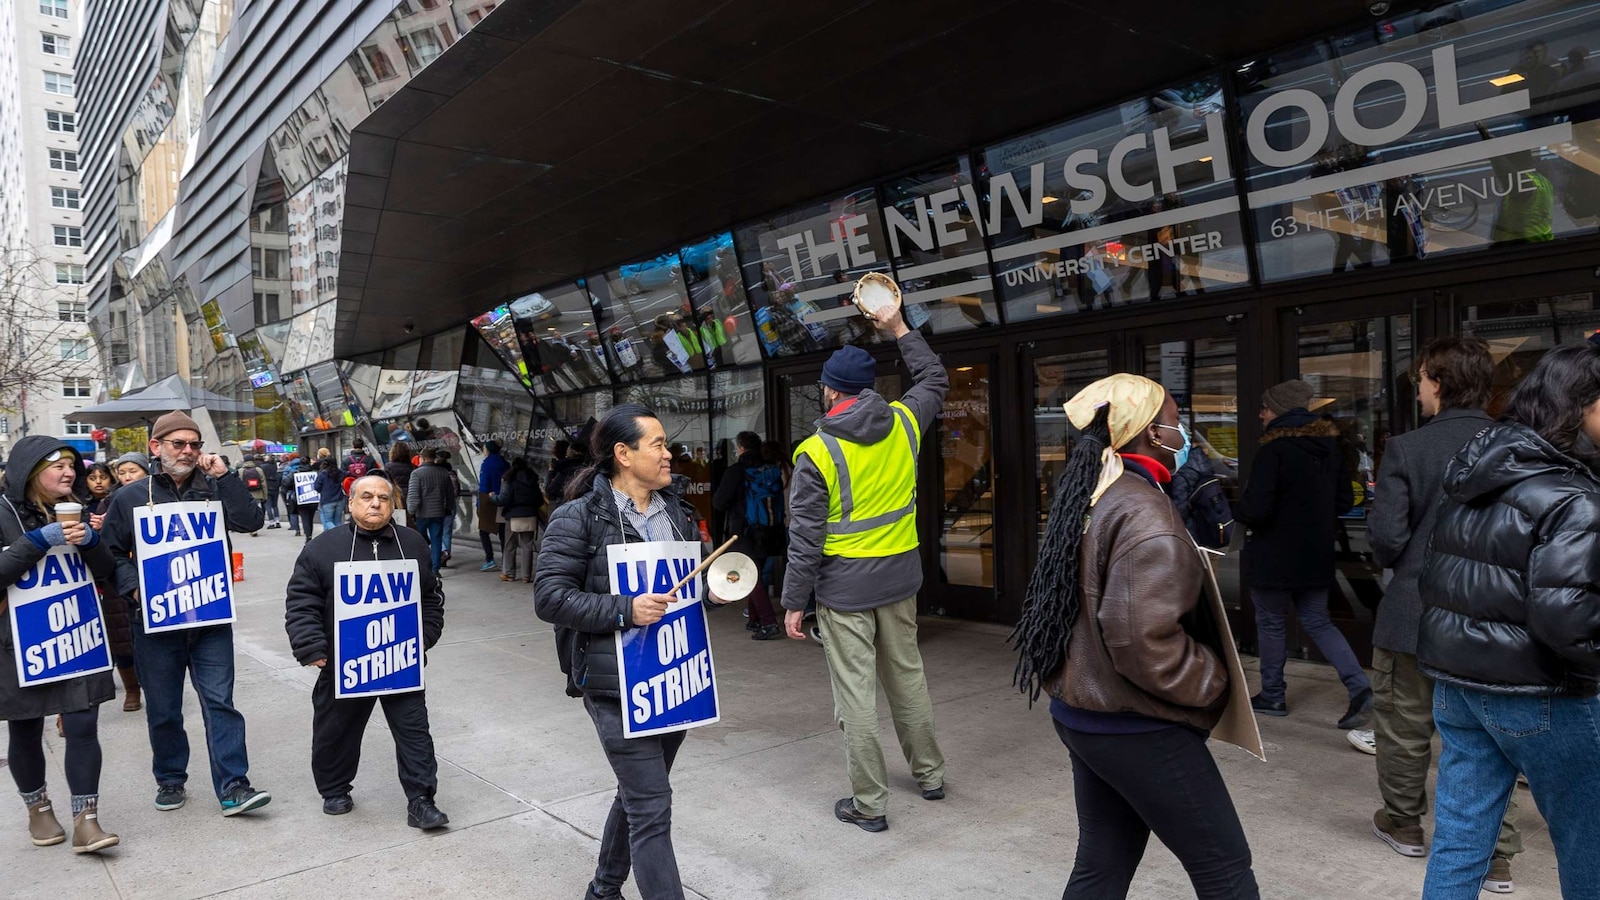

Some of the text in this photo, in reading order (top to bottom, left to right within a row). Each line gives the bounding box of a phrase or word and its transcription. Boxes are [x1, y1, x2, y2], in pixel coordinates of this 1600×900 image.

[777, 44, 1531, 282] THE NEW SCHOOL
[1270, 168, 1538, 238] 63 FIFTH AVENUE
[1004, 230, 1223, 287] UNIVERSITY CENTER
[296, 474, 316, 483] UAW
[140, 511, 217, 545] UAW
[170, 550, 201, 585] ON
[340, 572, 413, 605] UAW
[616, 558, 696, 600] UAW
[47, 594, 80, 633] ON
[150, 572, 227, 623] STRIKE
[25, 617, 103, 677] STRIKE
[366, 614, 396, 650] ON
[656, 615, 690, 666] ON
[343, 637, 417, 690] STRIKE
[631, 648, 711, 724] STRIKE
